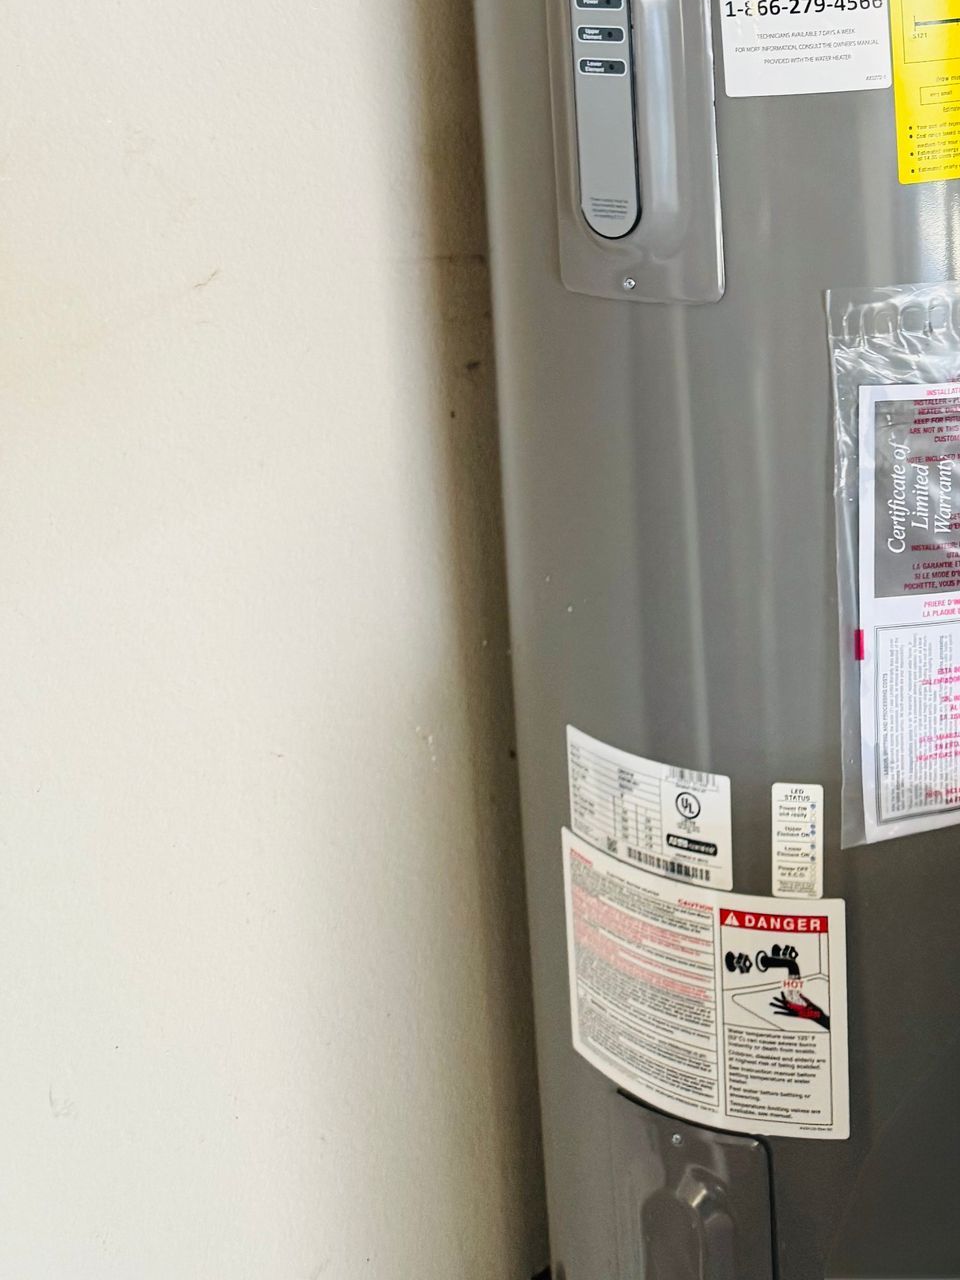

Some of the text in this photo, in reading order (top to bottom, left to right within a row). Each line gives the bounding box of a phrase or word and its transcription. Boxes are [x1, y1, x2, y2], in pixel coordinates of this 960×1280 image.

[887, 435, 911, 554] Certificate of
[911, 463, 929, 530] Limited
[933, 455, 954, 534] Warranty
[939, 579, 955, 588] VOUS
[924, 599, 946, 609] PRIERE
[932, 608, 956, 617] PLAQUE
[744, 915, 820, 931] DANGER
[783, 980, 804, 989] HOT
